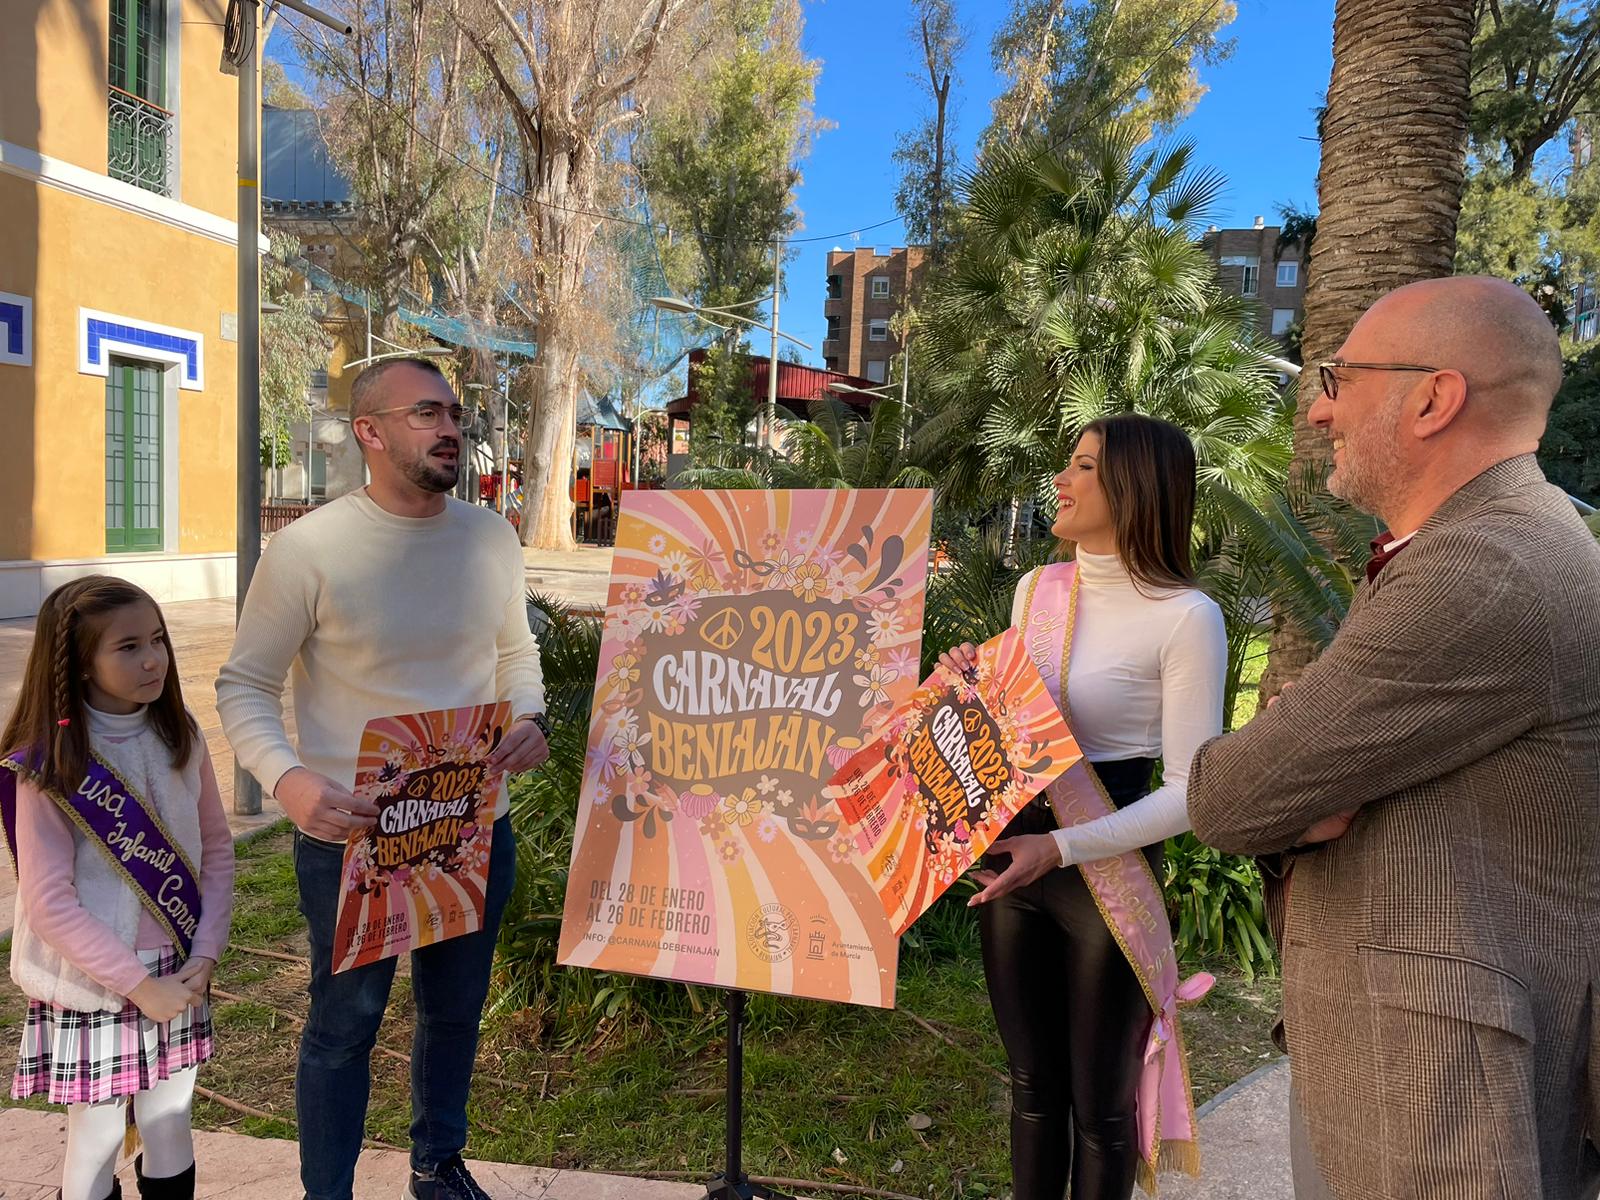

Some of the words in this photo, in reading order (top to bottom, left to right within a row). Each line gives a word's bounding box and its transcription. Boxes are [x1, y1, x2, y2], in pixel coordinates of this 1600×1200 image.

[750, 605, 859, 673] 2023
[652, 650, 843, 717] CARNAVAL
[648, 710, 836, 781] BENIAJÁN
[932, 705, 986, 808] CARNAVAL
[968, 723, 1009, 789] 2023
[431, 766, 481, 801] 2023
[77, 775, 126, 818] usa
[107, 821, 178, 874] Infantil
[380, 794, 469, 834] CARNAVAL
[384, 912, 405, 927] ENERO
[586, 902, 602, 923] AL
[607, 904, 625, 925] 26
[629, 906, 647, 928] DE
[651, 909, 711, 936] FEBRERO
[590, 879, 613, 901] DEL
[618, 882, 635, 903] 28
[640, 884, 657, 906] DE
[662, 887, 705, 911] ENERO
[379, 921, 408, 938] FEBRERO
